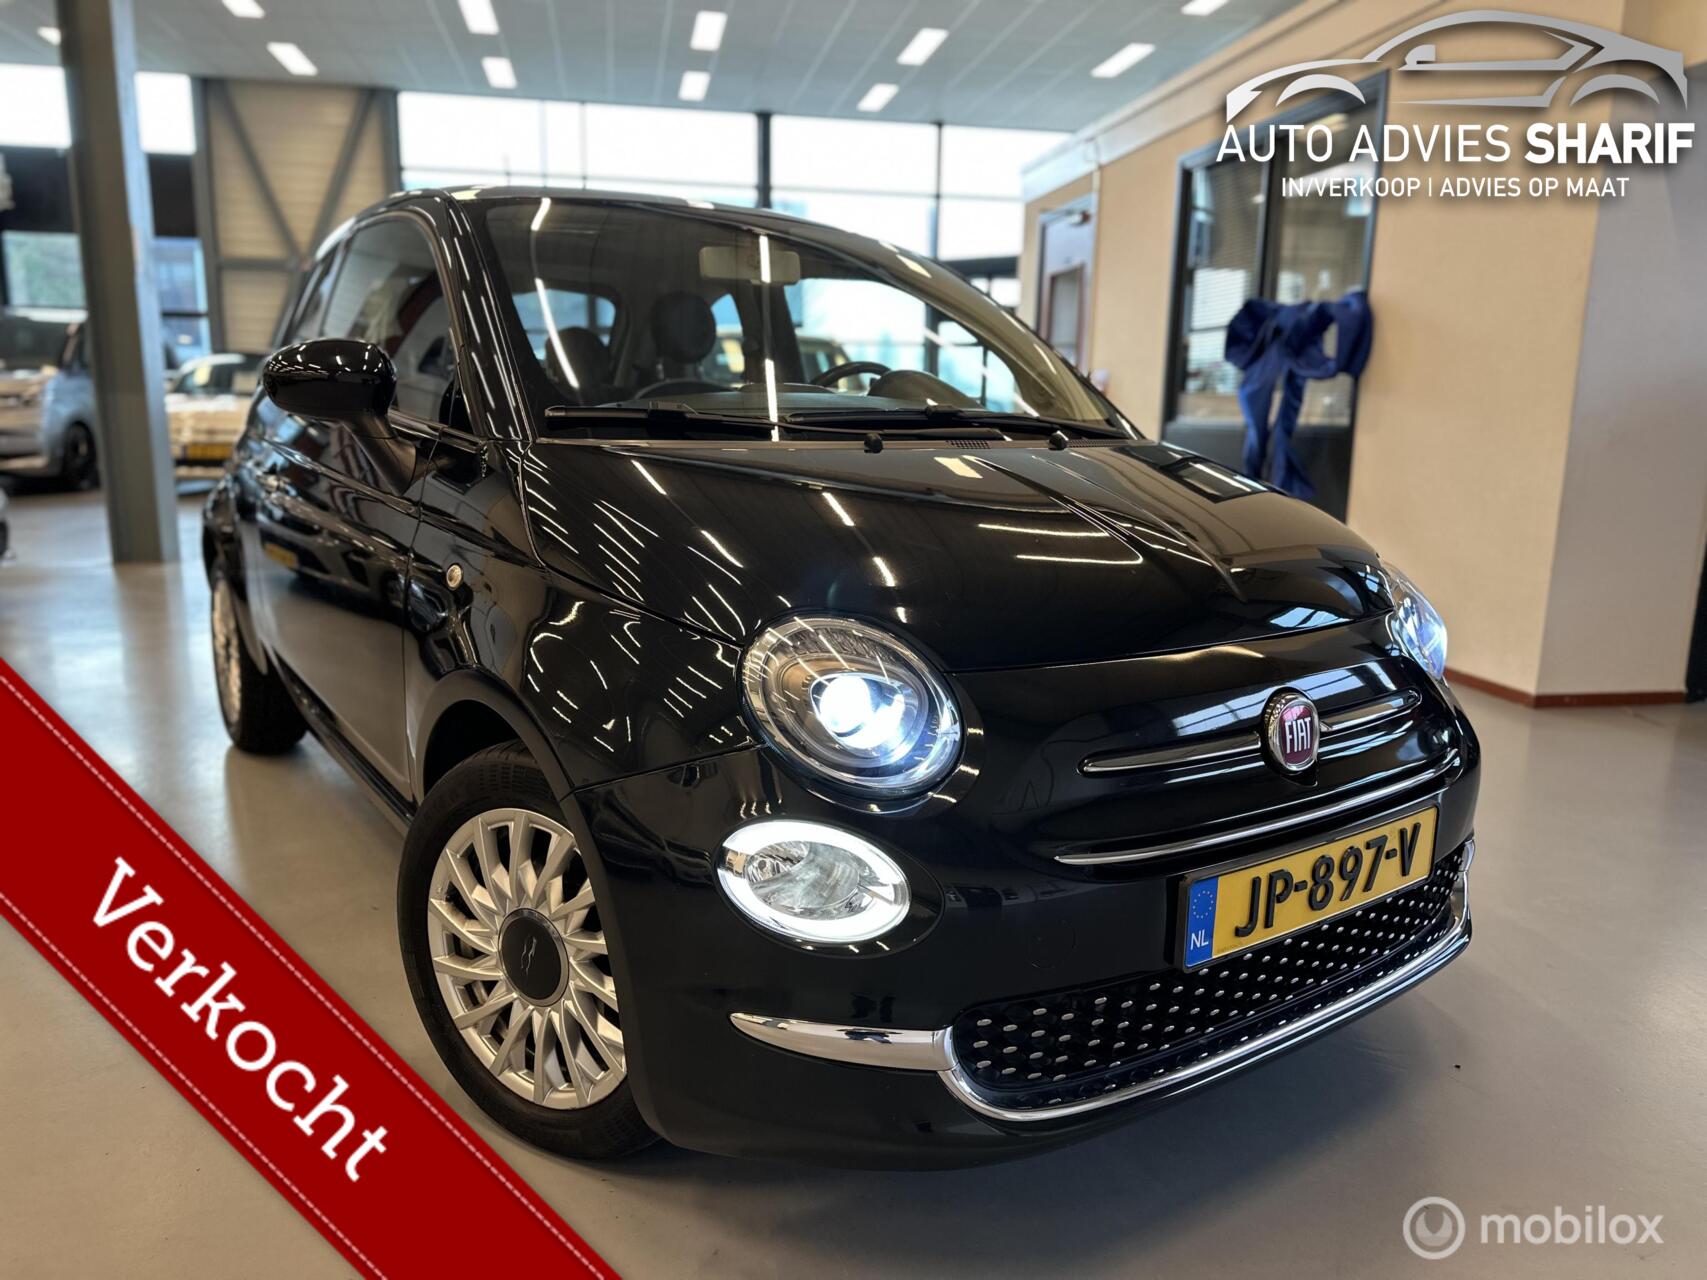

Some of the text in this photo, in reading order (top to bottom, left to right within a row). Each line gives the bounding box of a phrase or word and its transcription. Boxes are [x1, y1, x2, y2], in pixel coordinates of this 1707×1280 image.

[1284, 717, 1312, 754] FIAT
[1234, 822, 1422, 937] JP-897-V
[1189, 929, 1210, 951] NL
